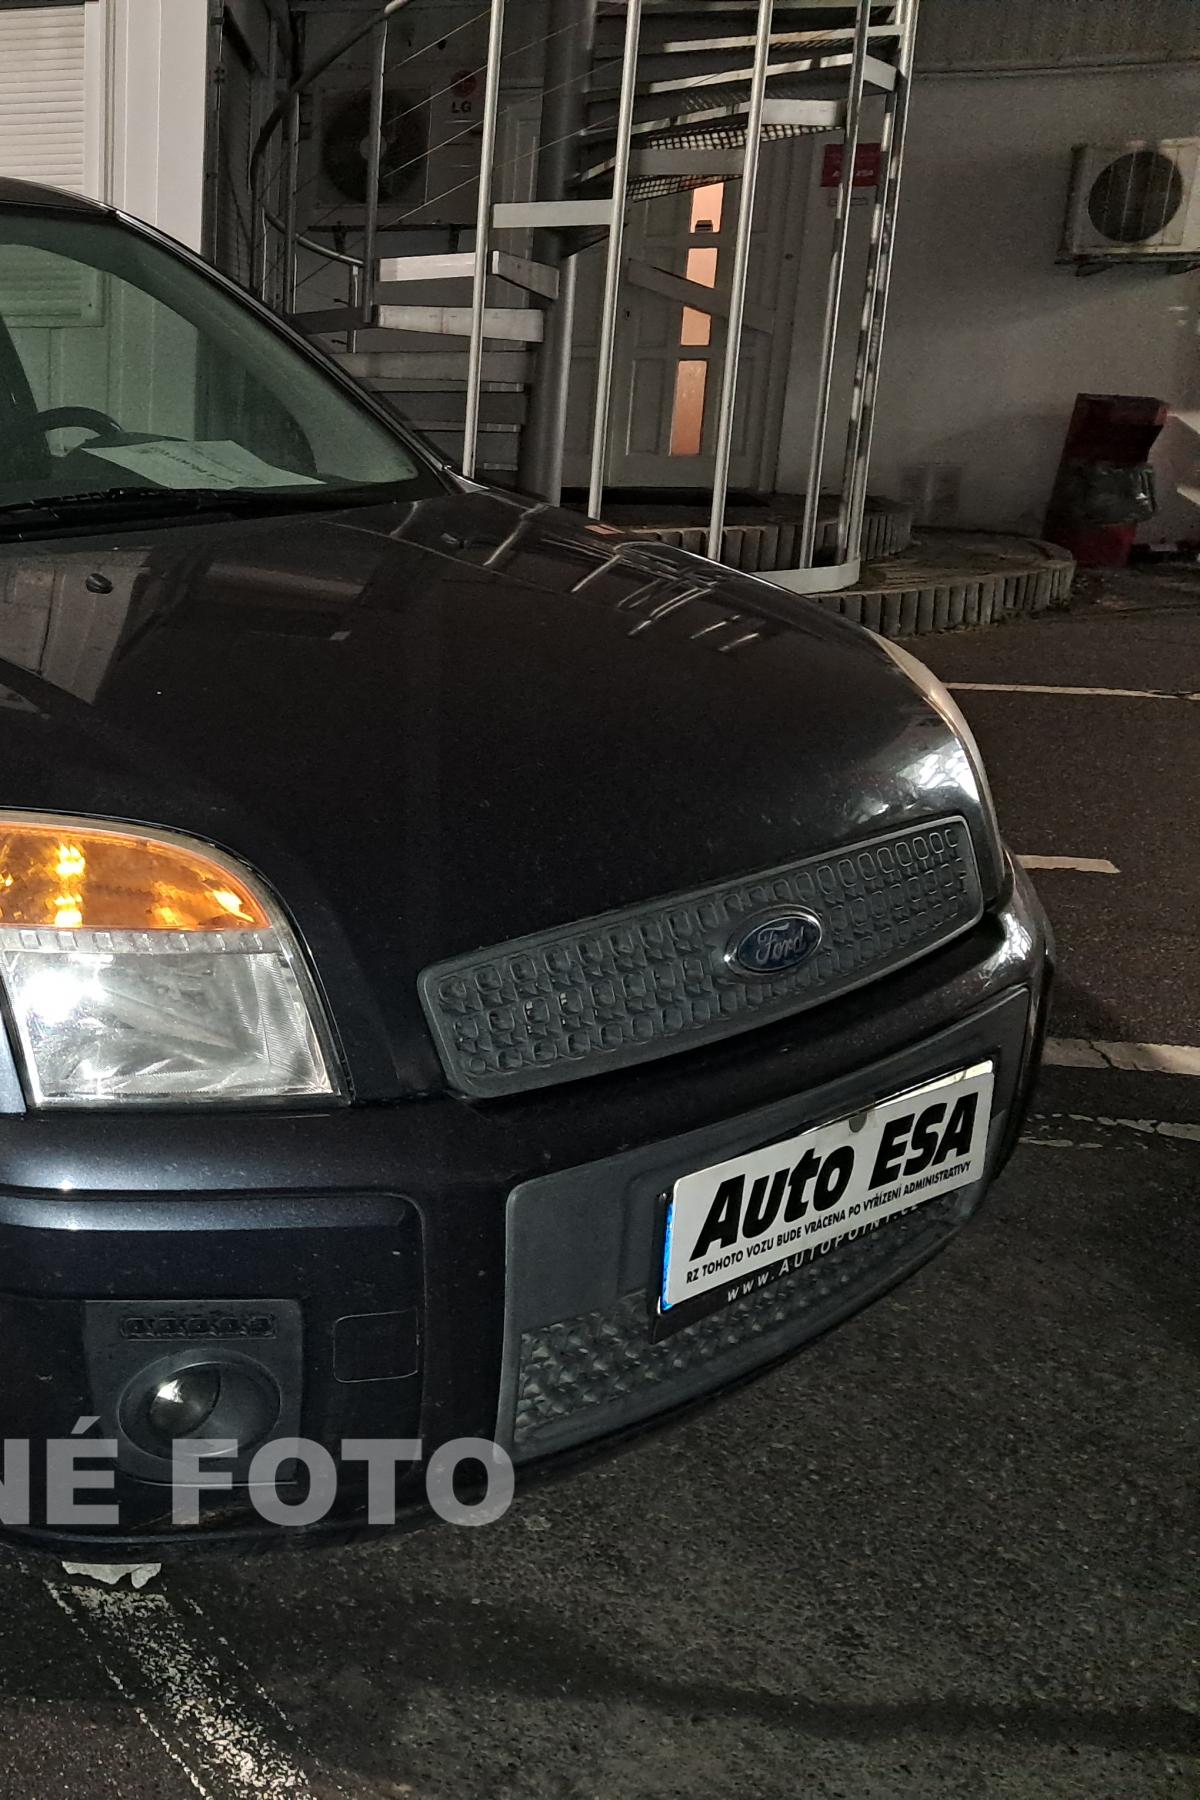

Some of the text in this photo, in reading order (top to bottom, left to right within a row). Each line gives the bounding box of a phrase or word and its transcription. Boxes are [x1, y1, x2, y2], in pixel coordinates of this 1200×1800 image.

[451, 100, 472, 114] LG
[755, 922, 806, 965] Ford
[688, 1091, 979, 1262] Auto ESA
[686, 1268, 699, 1284] RZ
[702, 1251, 743, 1277] TOHOTO
[746, 1237, 774, 1258] VOZU
[777, 1226, 802, 1246] BUDE
[804, 1209, 846, 1236] VRÁCENA
[848, 1203, 861, 1218] PO
[903, 1160, 972, 1197] ADMINISTRATIVY
